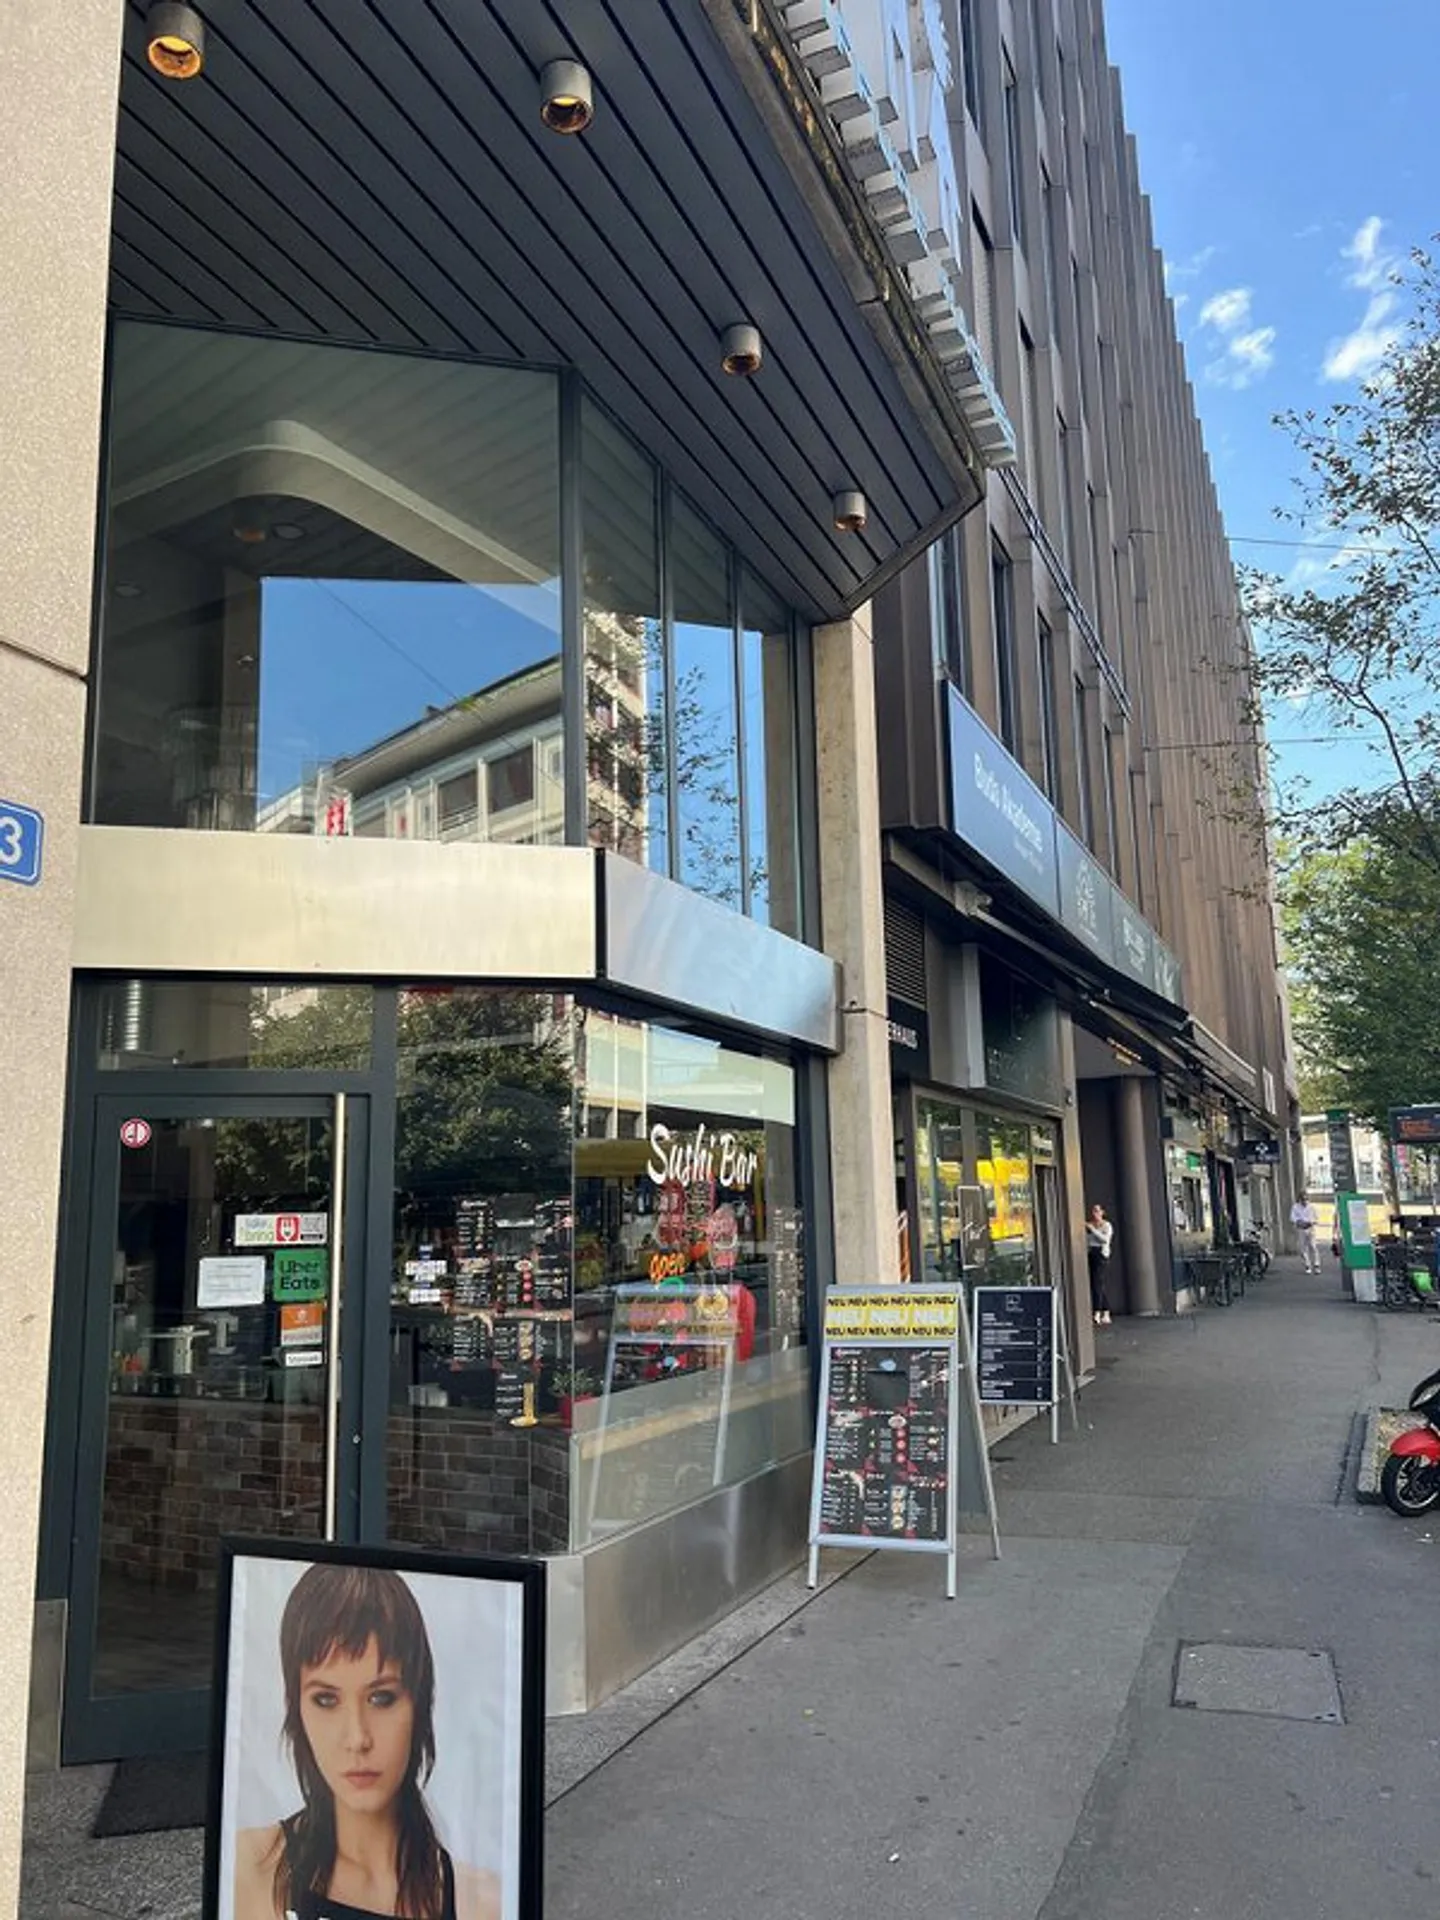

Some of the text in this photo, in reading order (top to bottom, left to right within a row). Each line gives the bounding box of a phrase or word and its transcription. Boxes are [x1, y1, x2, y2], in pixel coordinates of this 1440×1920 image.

[0, 816, 23, 865] 3
[648, 1123, 758, 1187] Sushi Bar
[280, 1260, 319, 1274] Uber
[280, 1276, 320, 1290] Eats
[826, 1308, 956, 1325] NEU NEU NEU
[826, 1327, 956, 1336] NEU NEU NEU NEU NEU NEU
